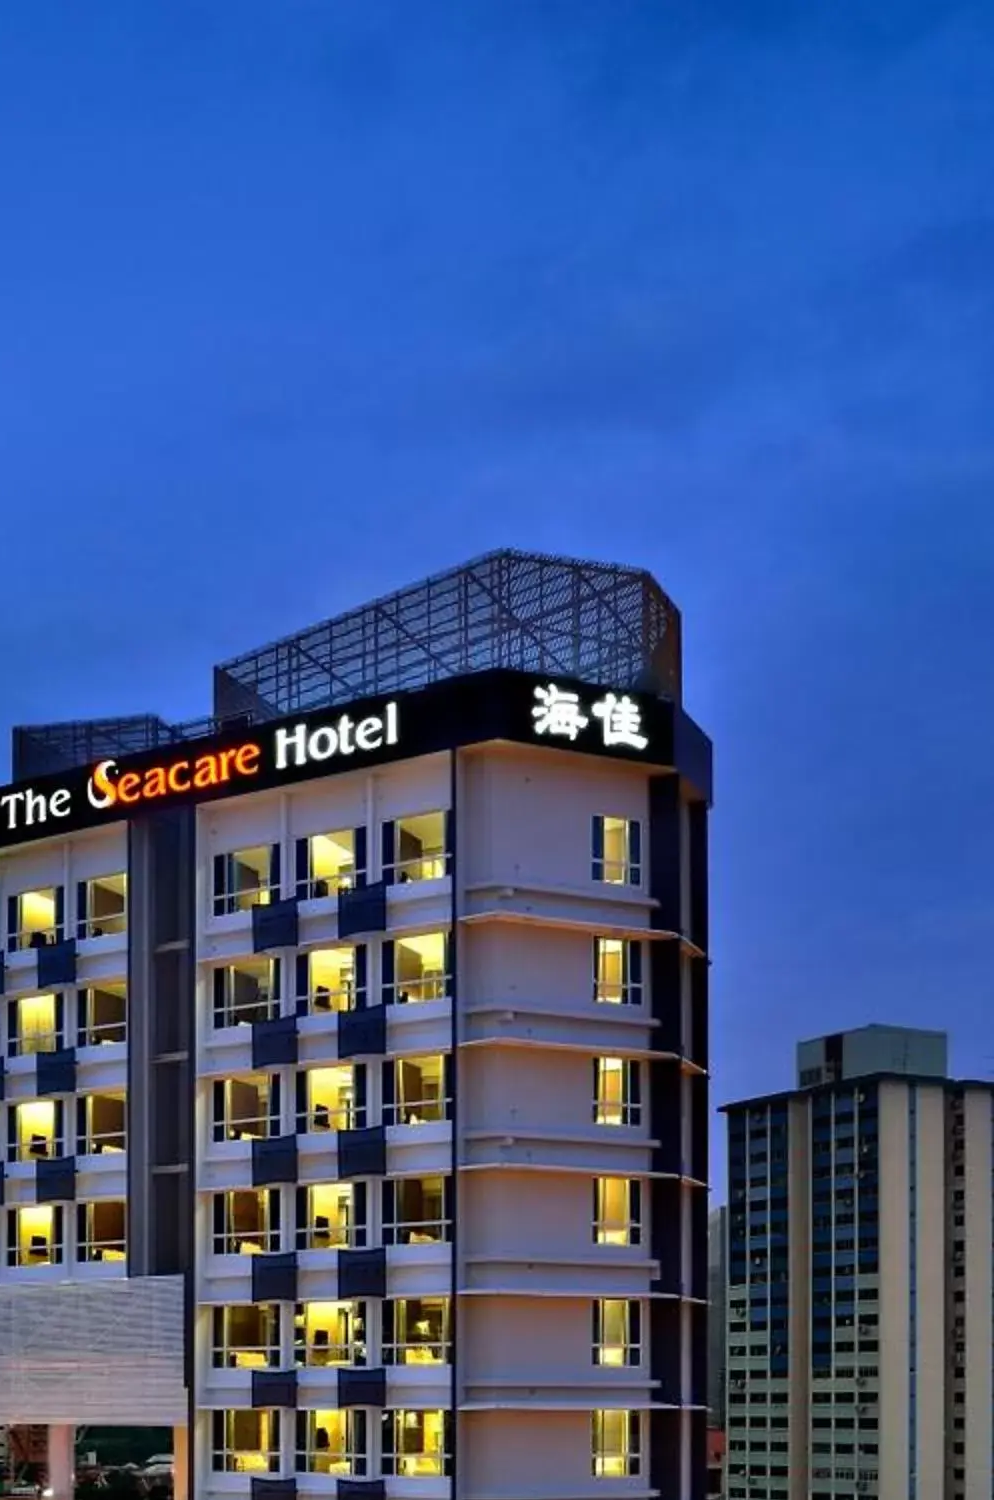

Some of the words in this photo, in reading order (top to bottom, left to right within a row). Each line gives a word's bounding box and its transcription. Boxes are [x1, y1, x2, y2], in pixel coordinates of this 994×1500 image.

[0, 787, 72, 829] The
[87, 743, 261, 809] Seacare
[275, 701, 398, 769] Hotel
[532, 683, 649, 750] 海佳
